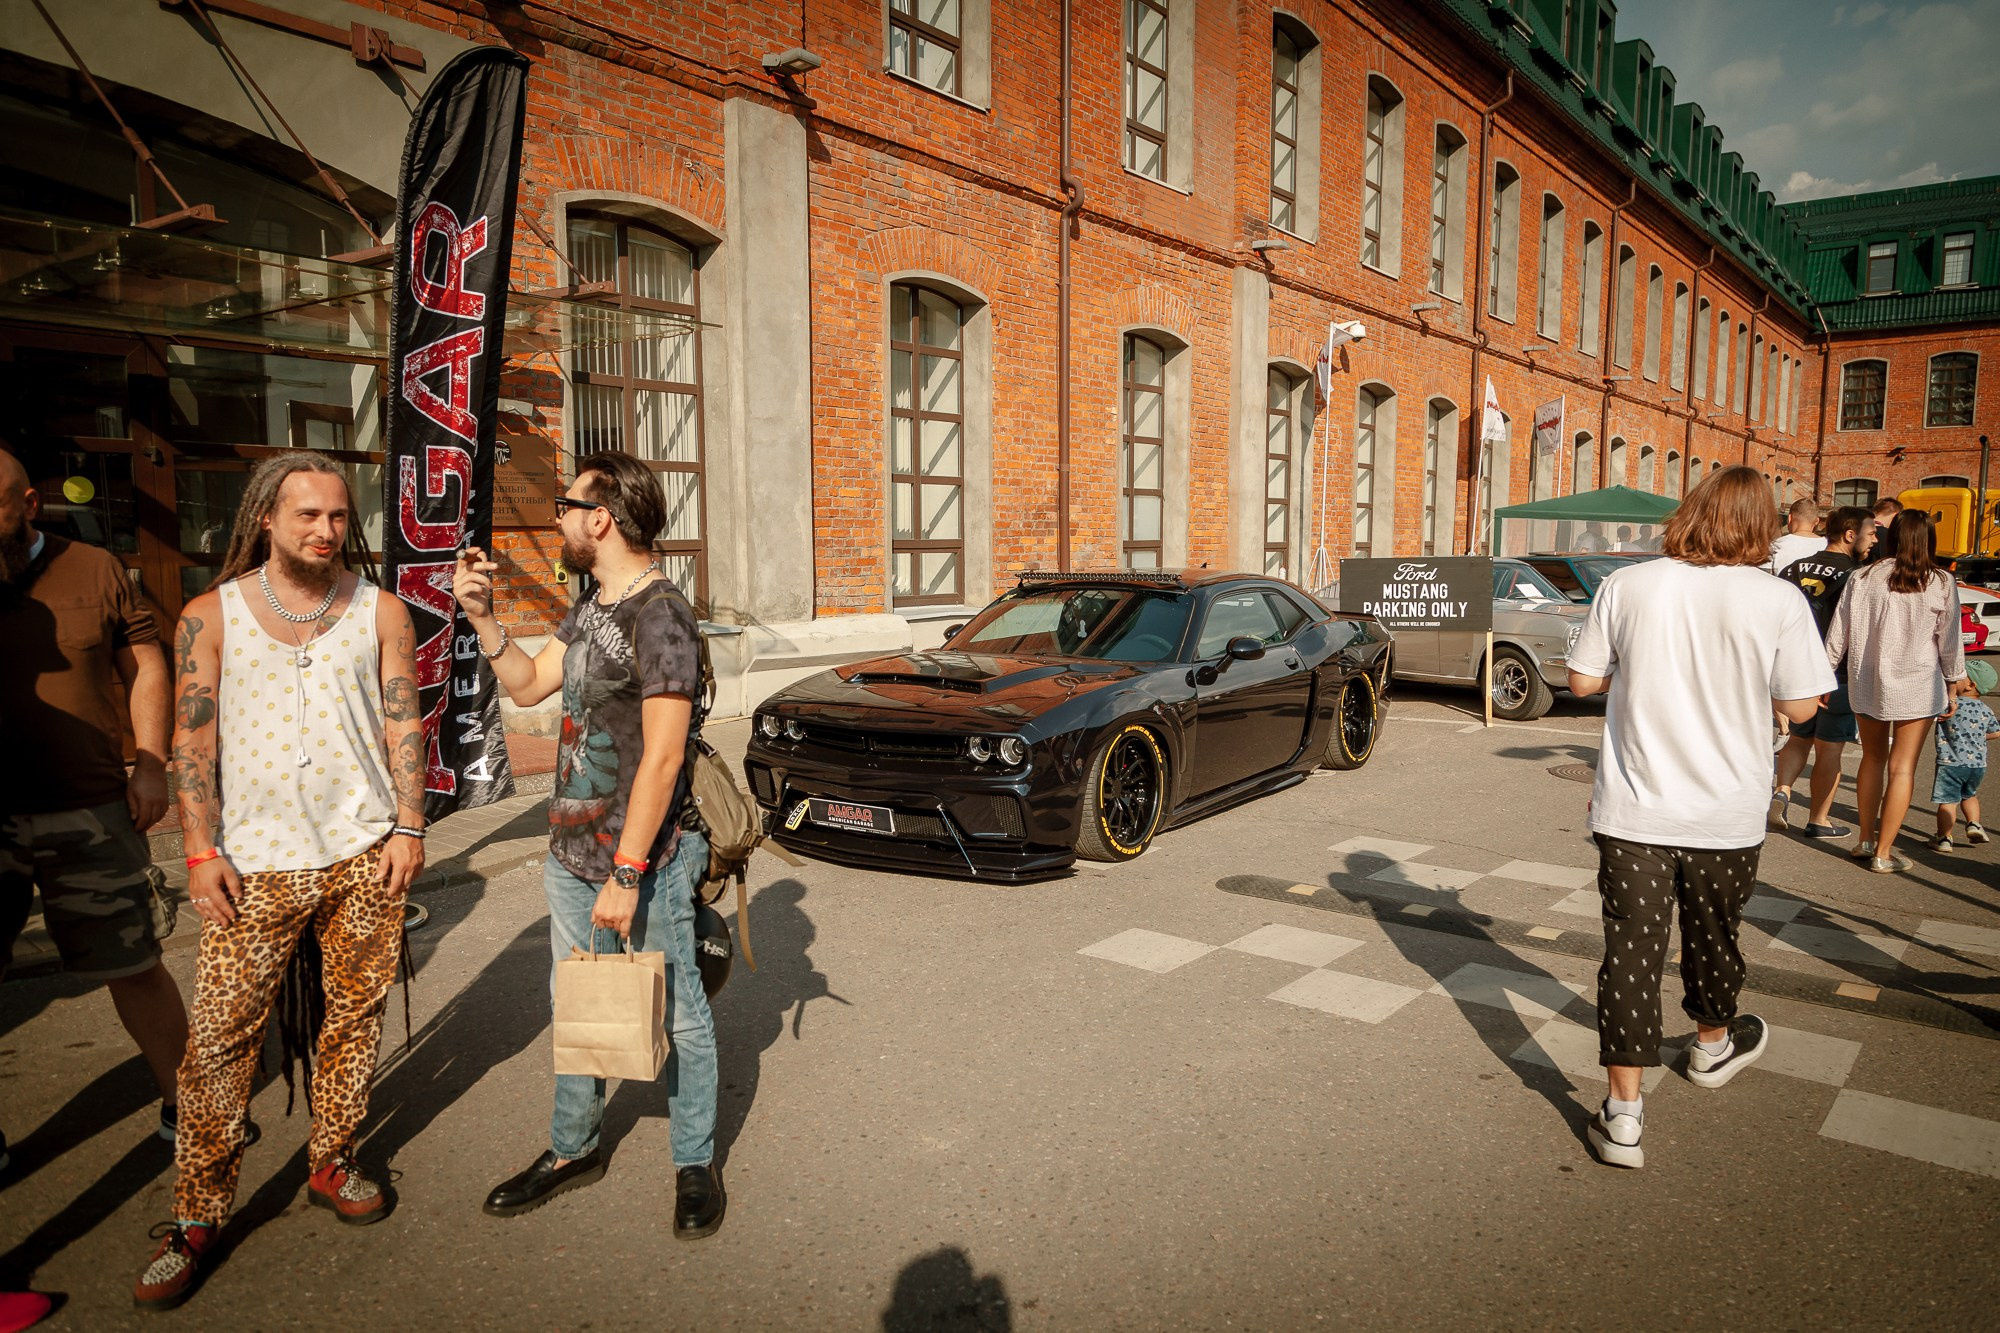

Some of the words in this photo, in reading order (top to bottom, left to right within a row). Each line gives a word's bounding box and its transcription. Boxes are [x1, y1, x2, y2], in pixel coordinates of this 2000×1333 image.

[493, 485, 527, 493] АВНЫЙ
[396, 200, 488, 796] AMGAR
[492, 506, 519, 514] ЕНТР»
[1393, 562, 1438, 581] Ford
[1383, 583, 1448, 599] MUSTANG
[1363, 602, 1426, 617] PARKING
[1431, 601, 1468, 618] ONLY
[828, 803, 873, 822] AMGAR
[828, 816, 853, 824] AMERICAN
[853, 820, 874, 828] GARAGE
